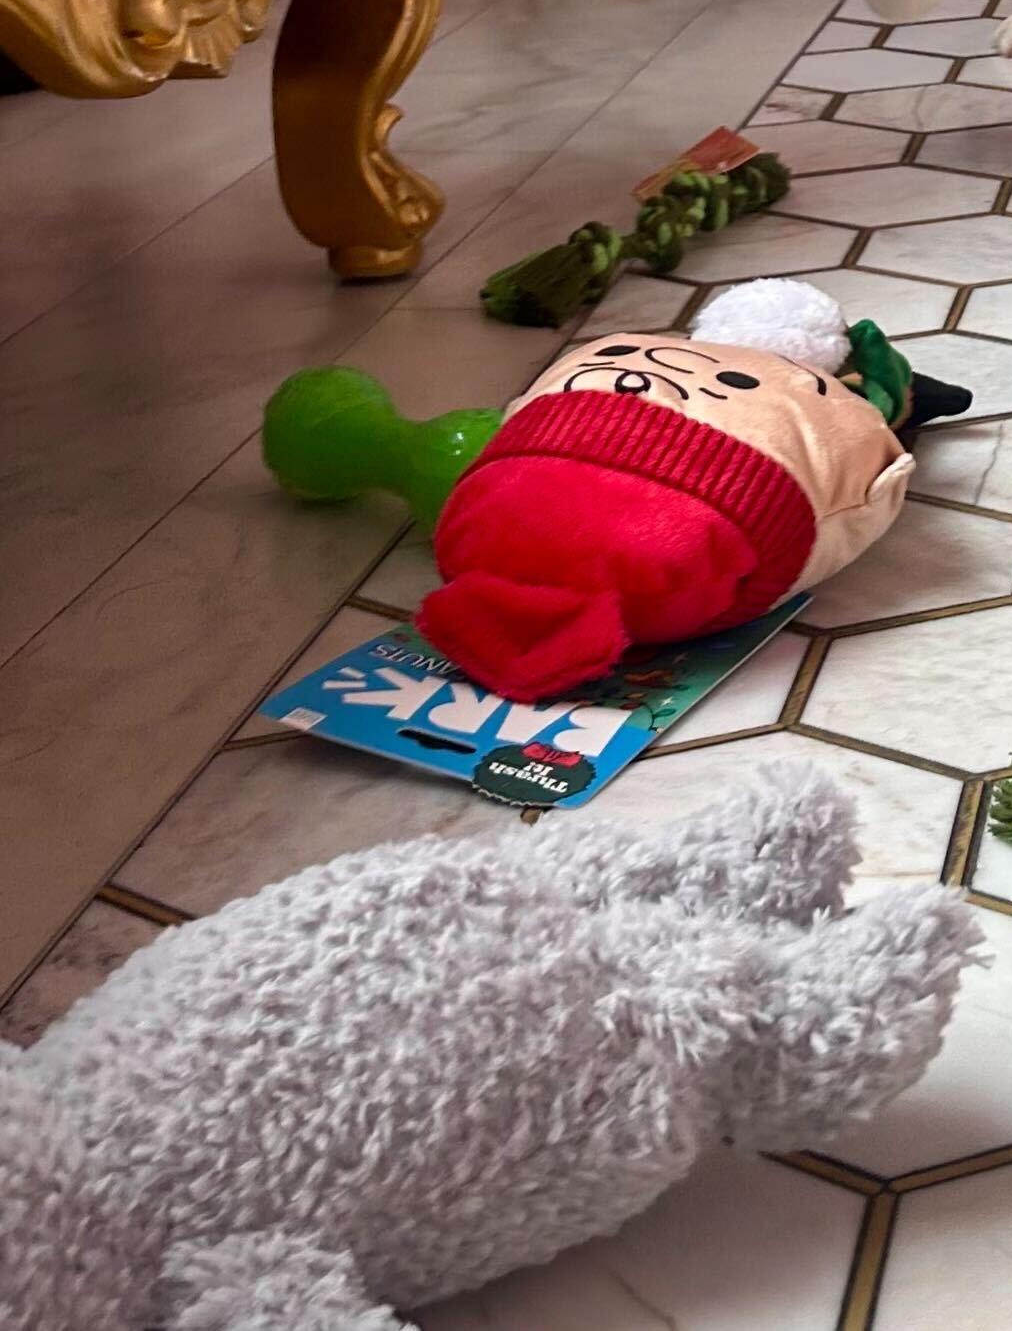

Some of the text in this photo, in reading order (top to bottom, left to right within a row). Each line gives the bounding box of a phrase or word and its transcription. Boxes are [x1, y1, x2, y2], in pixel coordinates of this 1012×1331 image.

[369, 644, 461, 676] ANUTS
[342, 667, 632, 757] BARK
[488, 761, 569, 793] Thrash
[521, 760, 554, 774] It!
